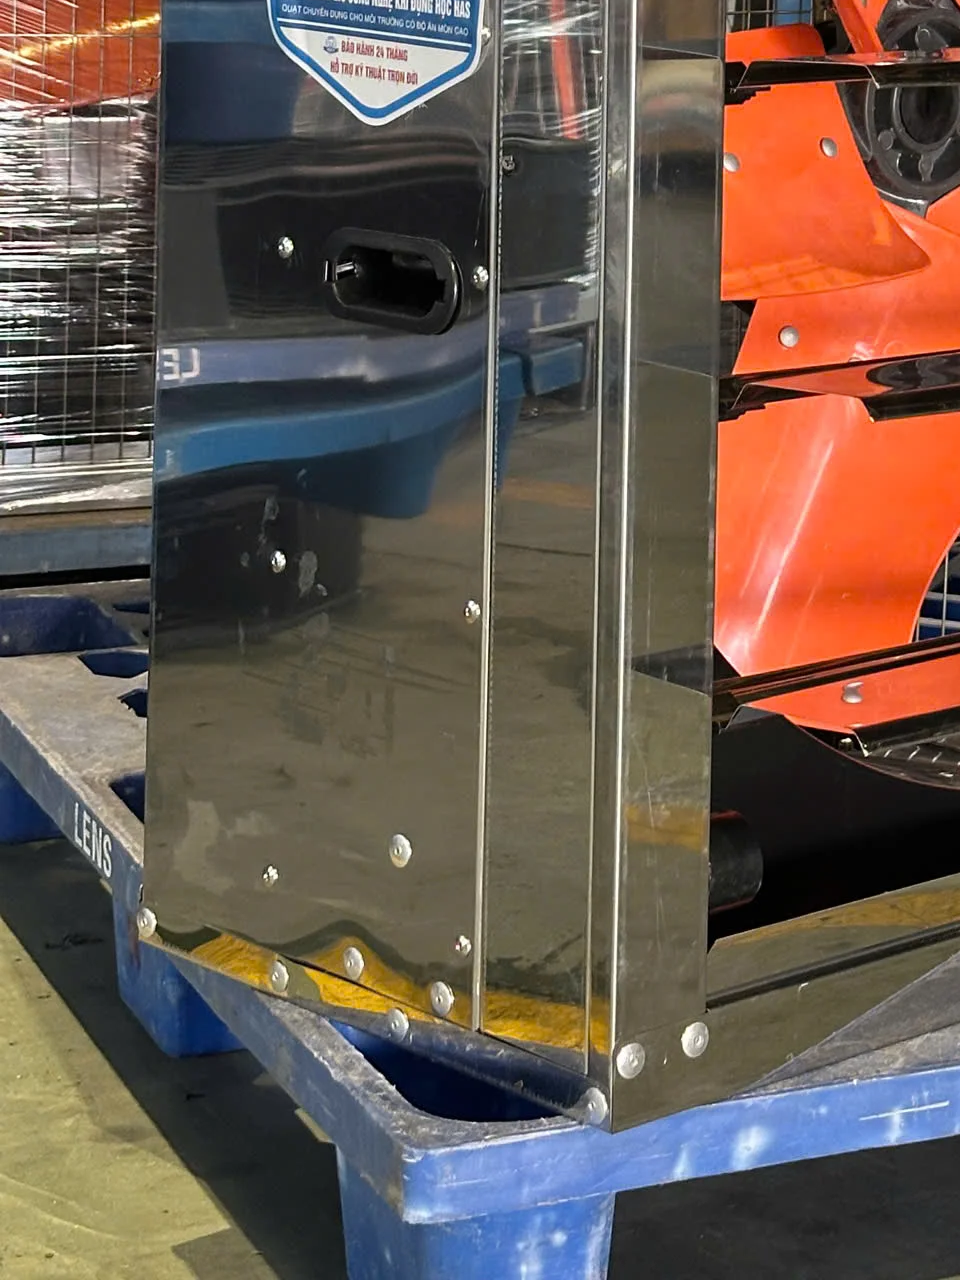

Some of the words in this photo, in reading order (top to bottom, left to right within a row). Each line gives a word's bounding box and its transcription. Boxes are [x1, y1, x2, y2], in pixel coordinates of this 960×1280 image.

[282, 4, 301, 15] QUẠT
[303, 6, 329, 17] CHUYÊN
[330, 9, 348, 20] DỤNG
[349, 12, 364, 22] CHO
[454, 26, 469, 37] CAO
[453, 0, 471, 19] HAS
[341, 37, 355, 53] BẢO
[356, 41, 374, 56] HÀNH
[376, 45, 384, 58] 24
[386, 45, 408, 61] THÁNG
[341, 62, 354, 77] TRỢ
[365, 65, 386, 82] THUẬT
[388, 69, 405, 85] TRỌN
[74, 802, 112, 878] LENS
